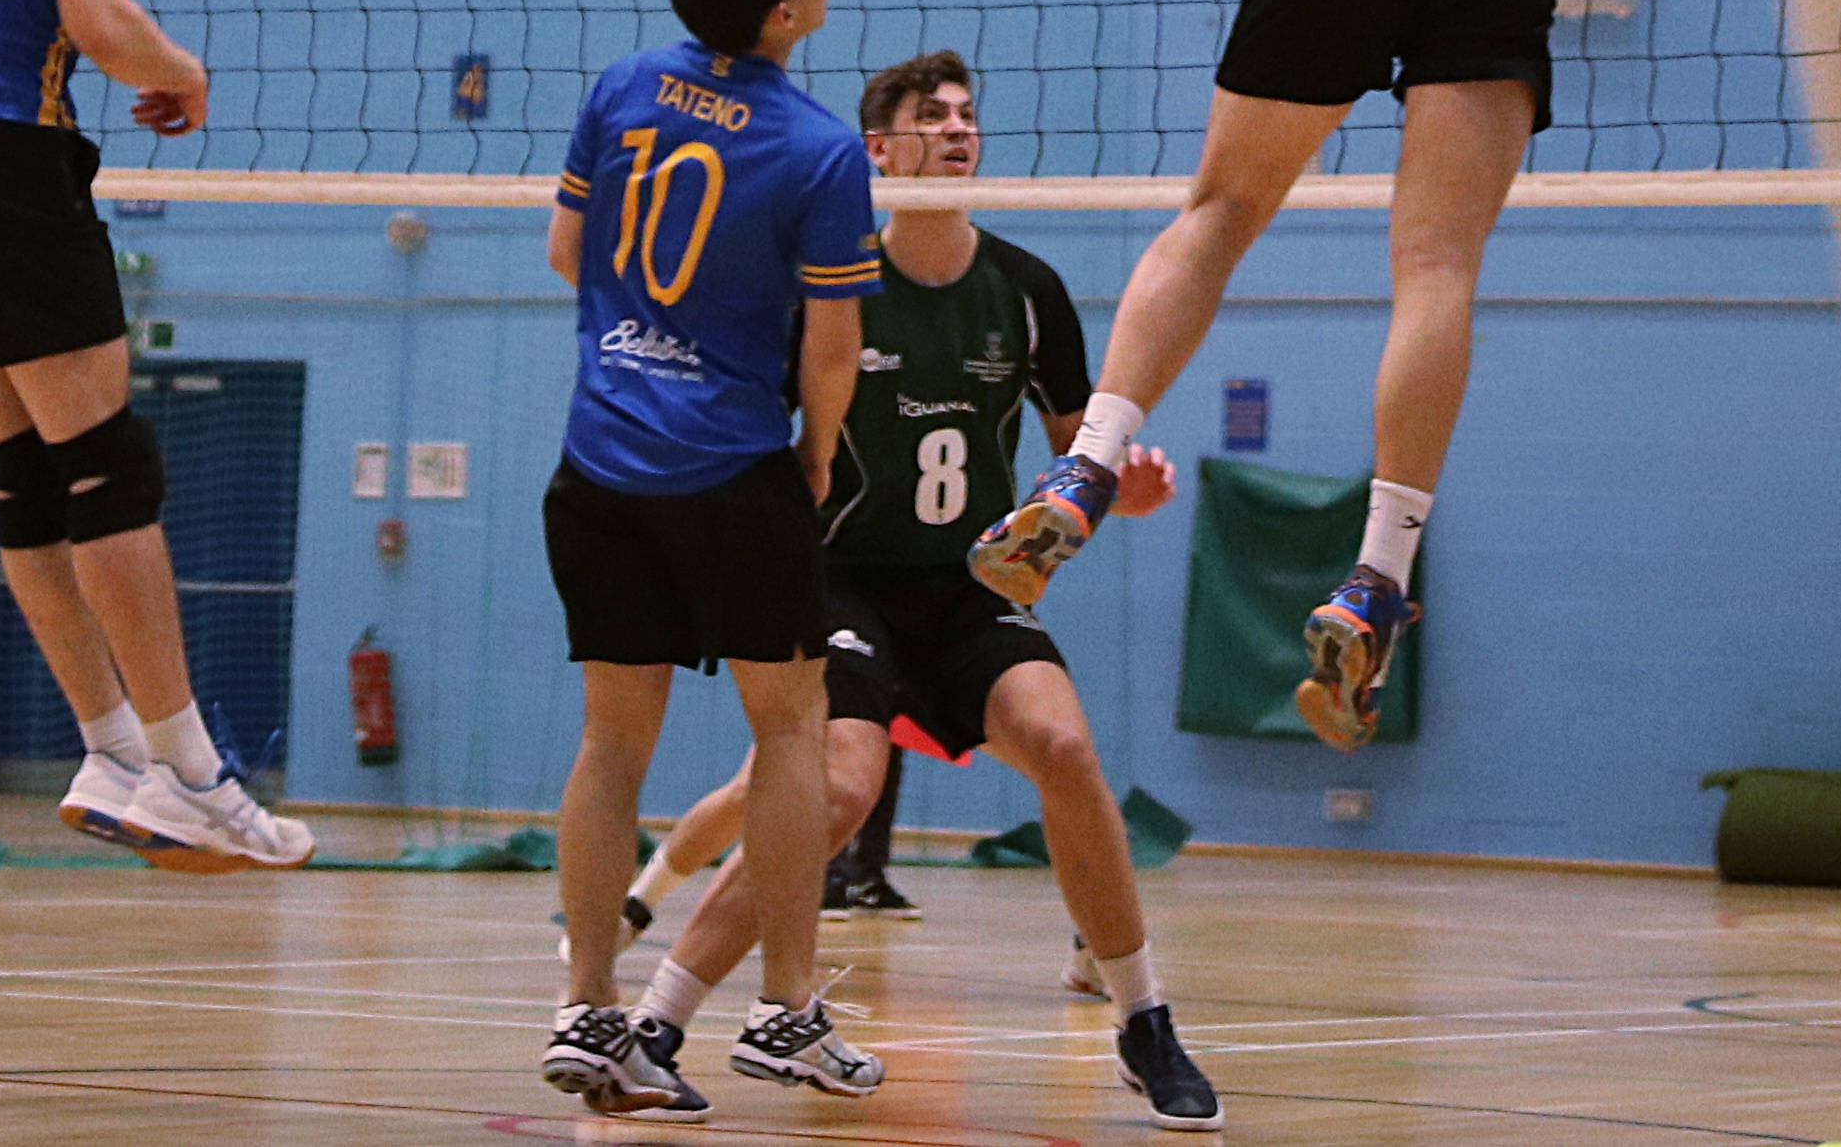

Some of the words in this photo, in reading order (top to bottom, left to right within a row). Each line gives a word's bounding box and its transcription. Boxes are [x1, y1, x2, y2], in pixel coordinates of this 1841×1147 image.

[656, 74, 752, 132] TATENO
[613, 128, 725, 306] 10
[915, 428, 968, 526] 8
